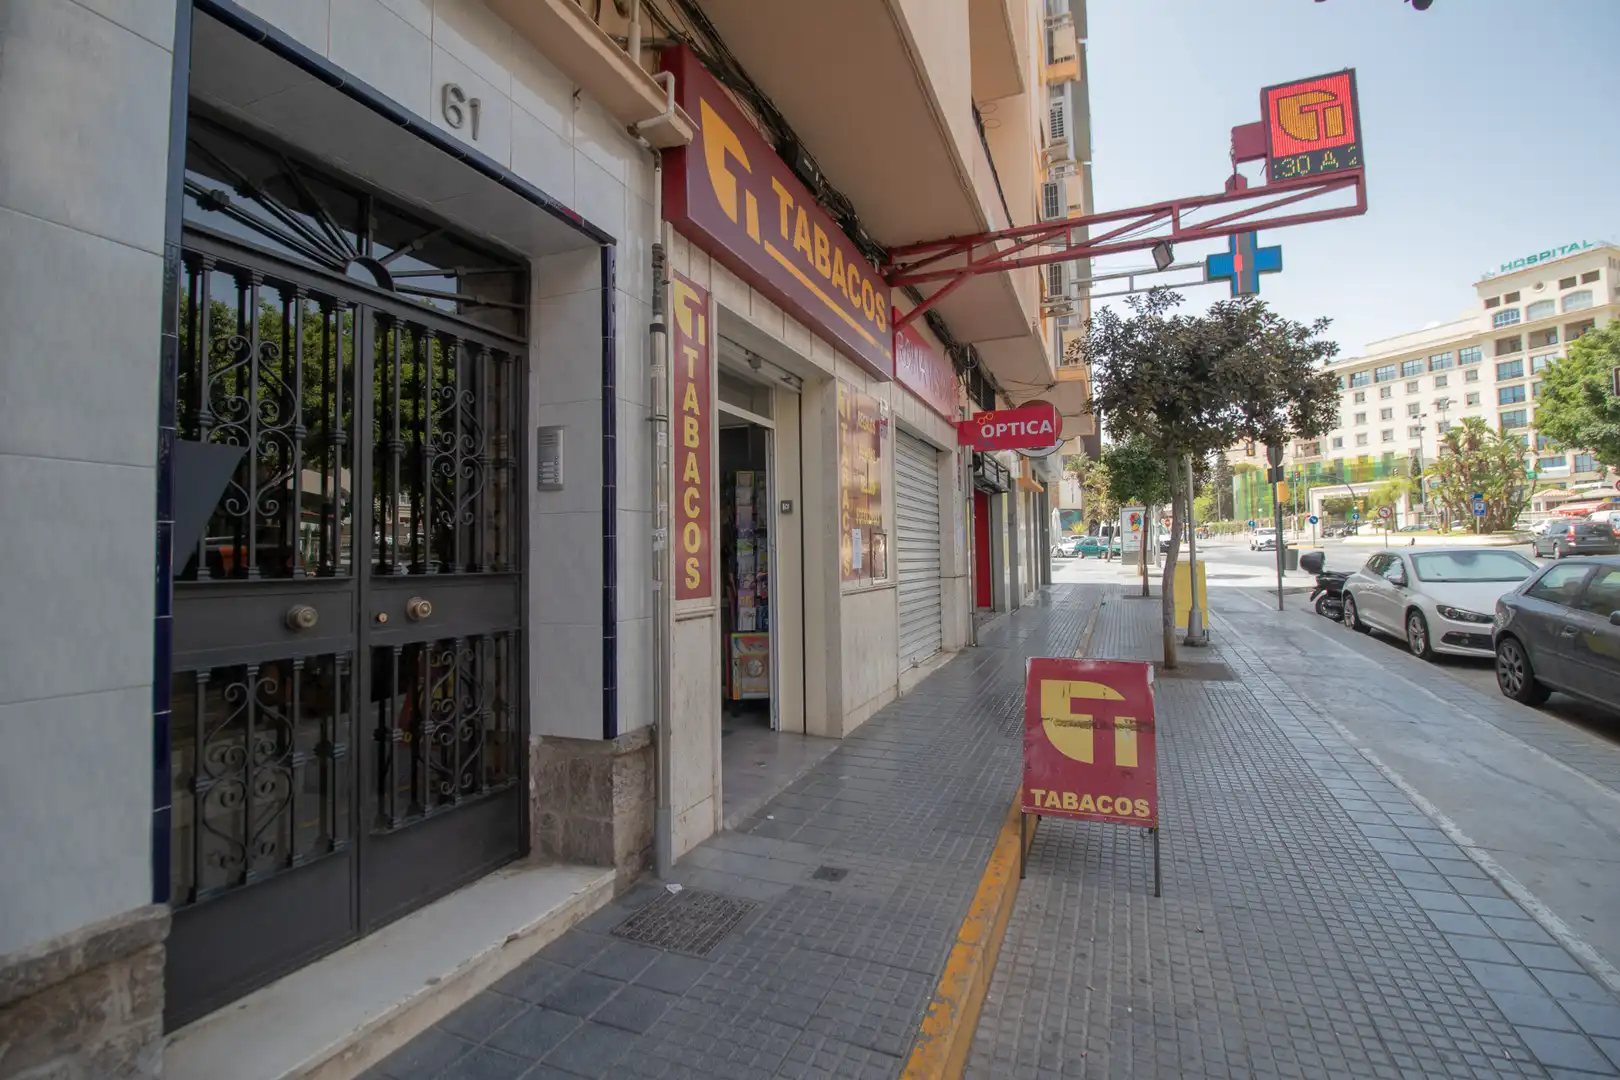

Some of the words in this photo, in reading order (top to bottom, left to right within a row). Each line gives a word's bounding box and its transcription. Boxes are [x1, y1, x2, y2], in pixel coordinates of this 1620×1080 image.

[441, 83, 481, 141] 61
[772, 176, 887, 333] TABACOS
[1501, 240, 1593, 272] HOSPITAL
[981, 420, 1053, 438] OPTICA
[682, 348, 701, 589] TABACOS
[841, 423, 851, 577] TABACOS
[1030, 788, 1151, 818] TABACOS
